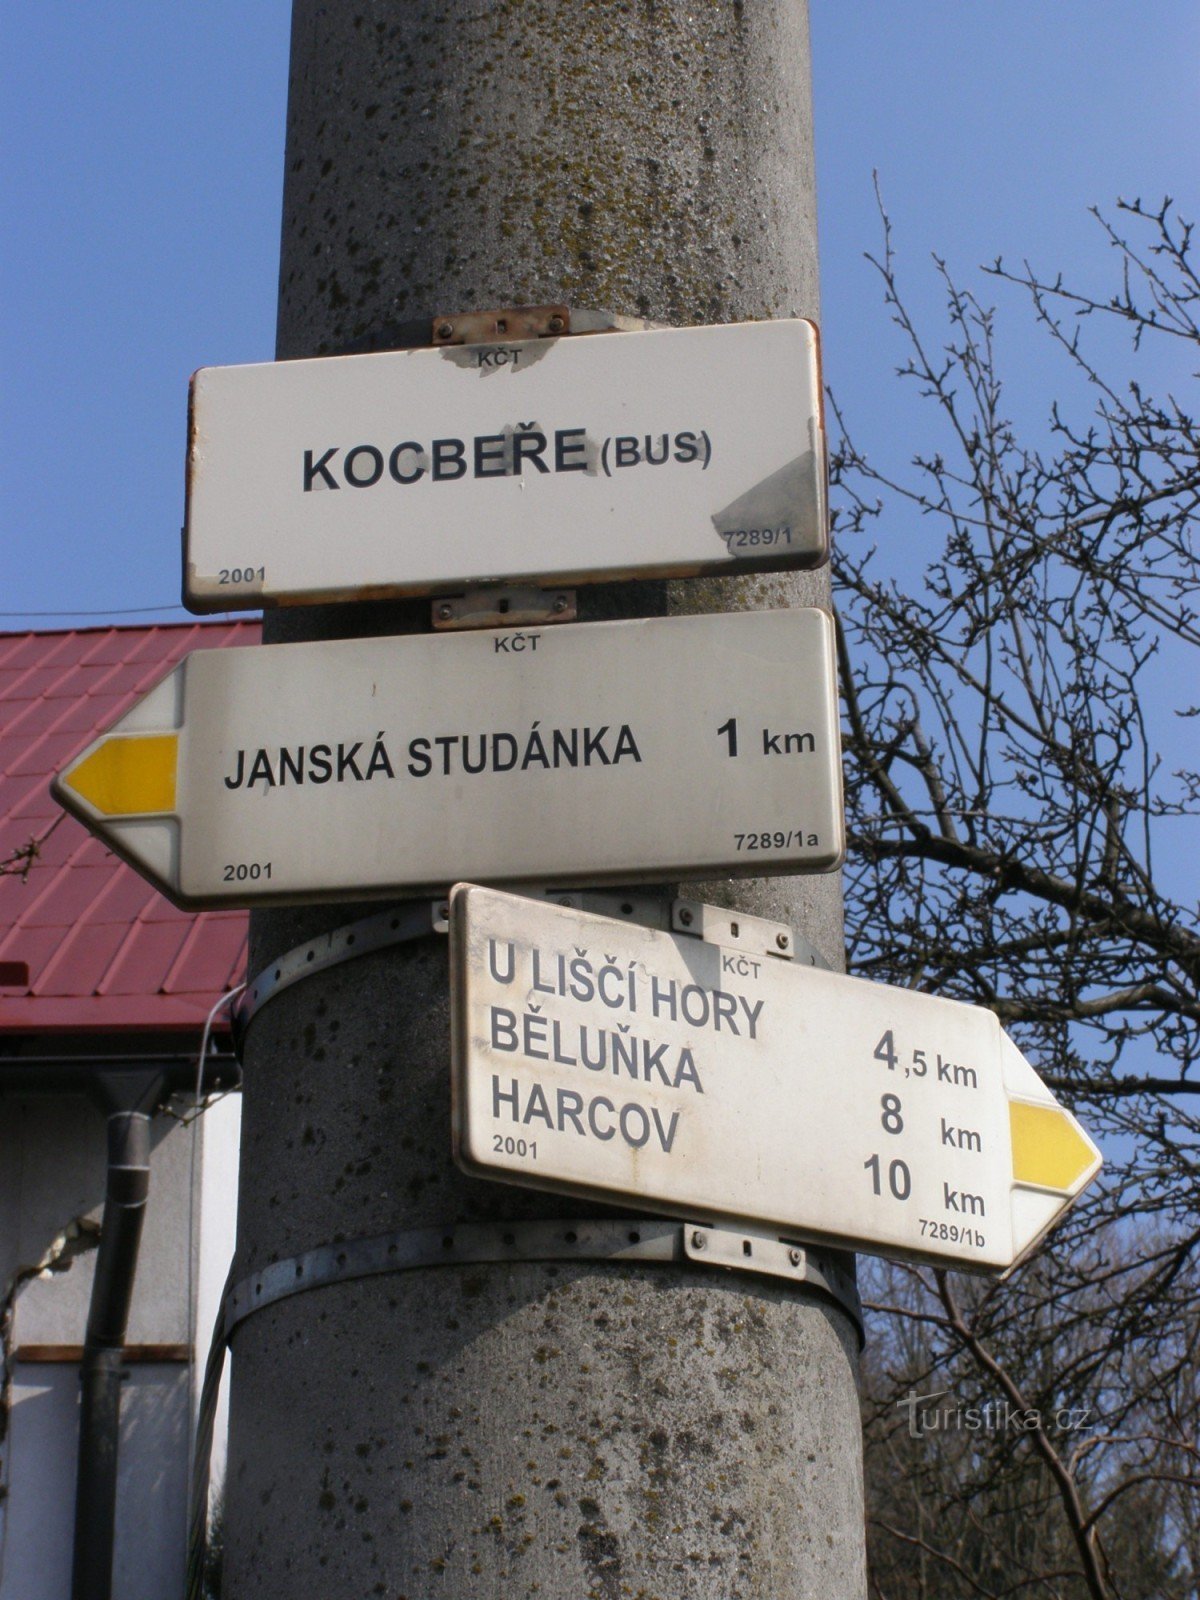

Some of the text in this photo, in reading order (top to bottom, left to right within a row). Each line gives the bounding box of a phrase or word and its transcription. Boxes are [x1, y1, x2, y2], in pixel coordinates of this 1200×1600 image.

[477, 348, 523, 368] KČT
[303, 422, 712, 493] KOCBEŘE (BUS)
[724, 527, 793, 549] 7289/1
[219, 567, 266, 586] 2001
[493, 632, 541, 654] KČT
[224, 718, 816, 790] JANSKÁ STUDÁNKA 1 km
[733, 830, 819, 851] 7289/1a
[222, 862, 273, 882] 2001
[722, 954, 762, 980] KČT
[488, 938, 978, 1089] U LIŠČÍ HORY 4,5 km
[489, 1003, 983, 1153] BĚLUŇKA 8 km
[491, 1073, 986, 1218] HARCOV 10 km
[493, 1134, 539, 1160] 2001
[918, 1219, 987, 1249] 7289/1b
